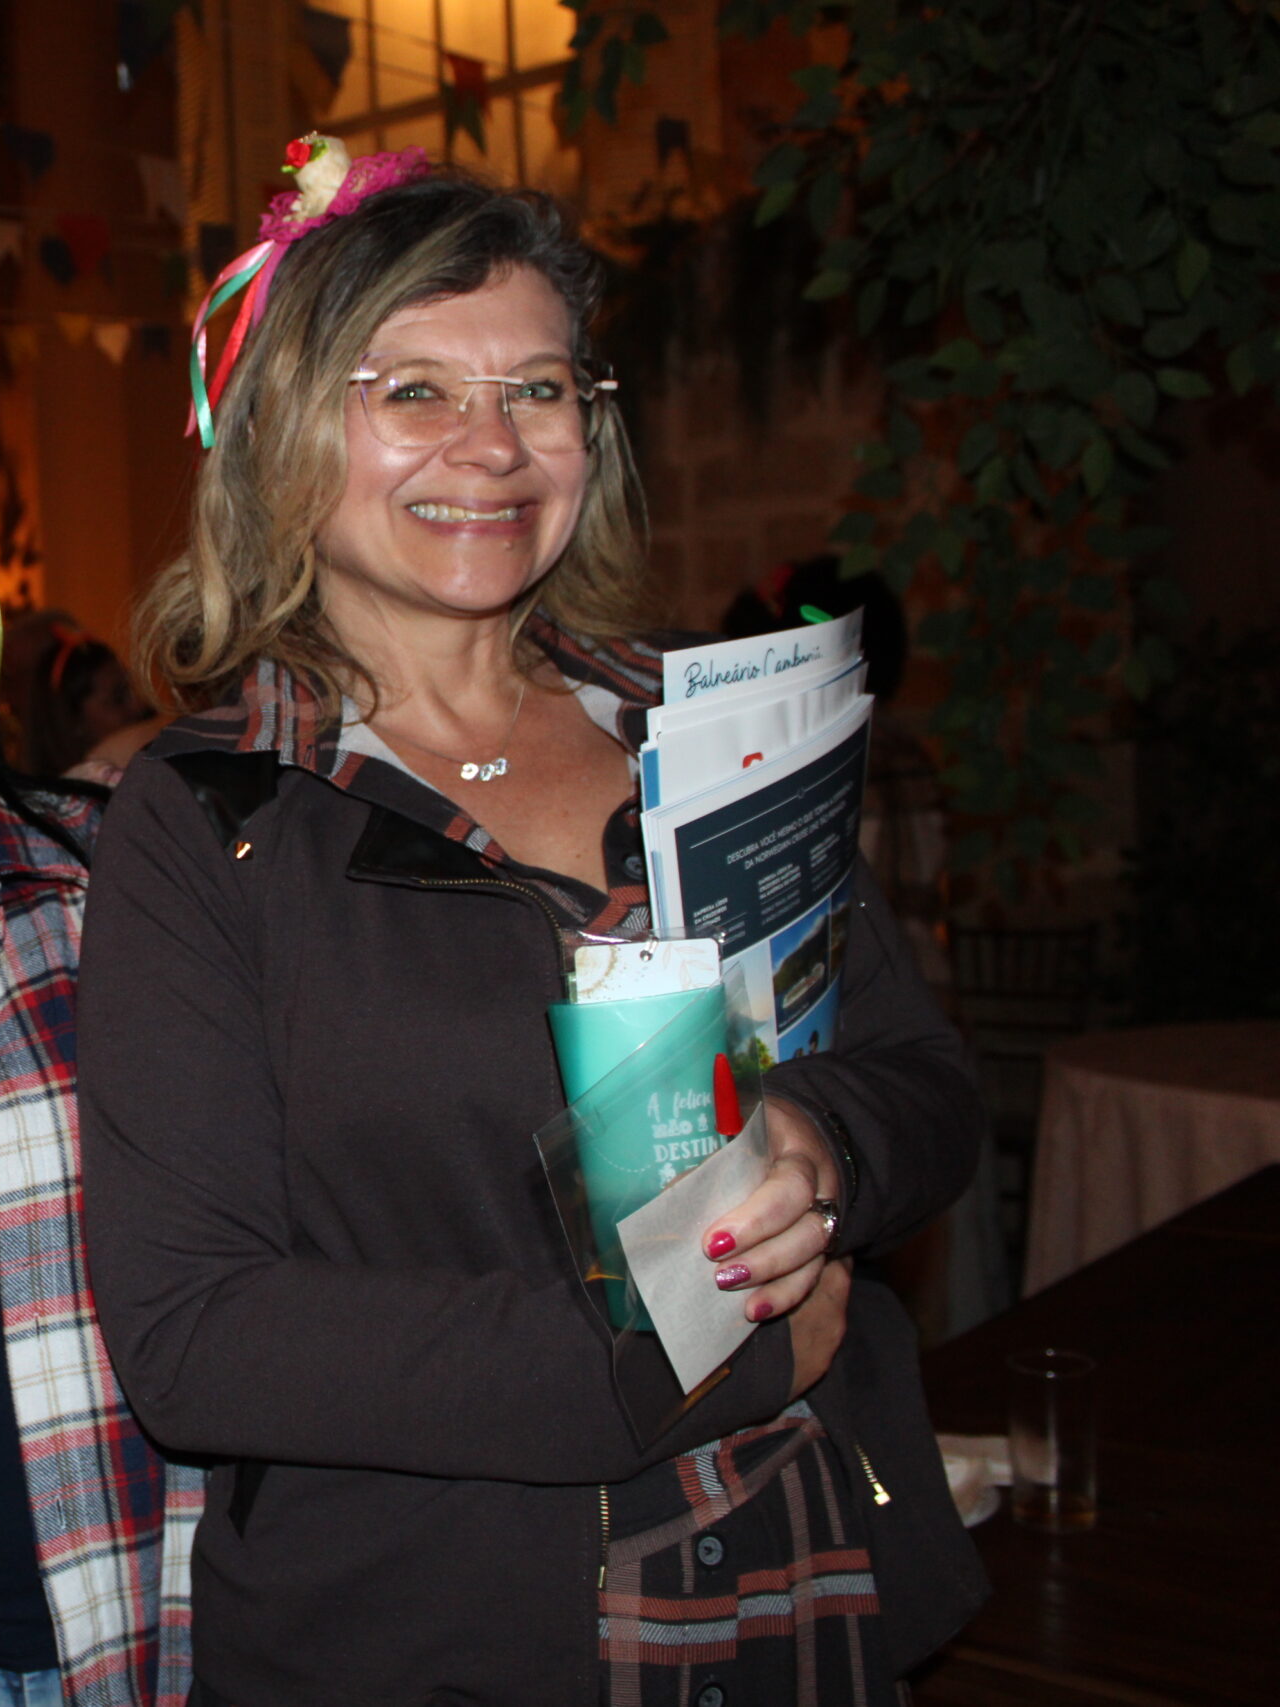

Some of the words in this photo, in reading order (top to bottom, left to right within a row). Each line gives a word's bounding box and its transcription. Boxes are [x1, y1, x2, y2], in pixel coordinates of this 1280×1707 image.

[684, 659, 761, 699] Balneário
[726, 842, 759, 865] DESCUBRA
[760, 830, 776, 847] VOCÊ
[647, 1092, 660, 1122] A
[673, 1088, 711, 1118] felici
[652, 1135, 720, 1162] DESTIN
